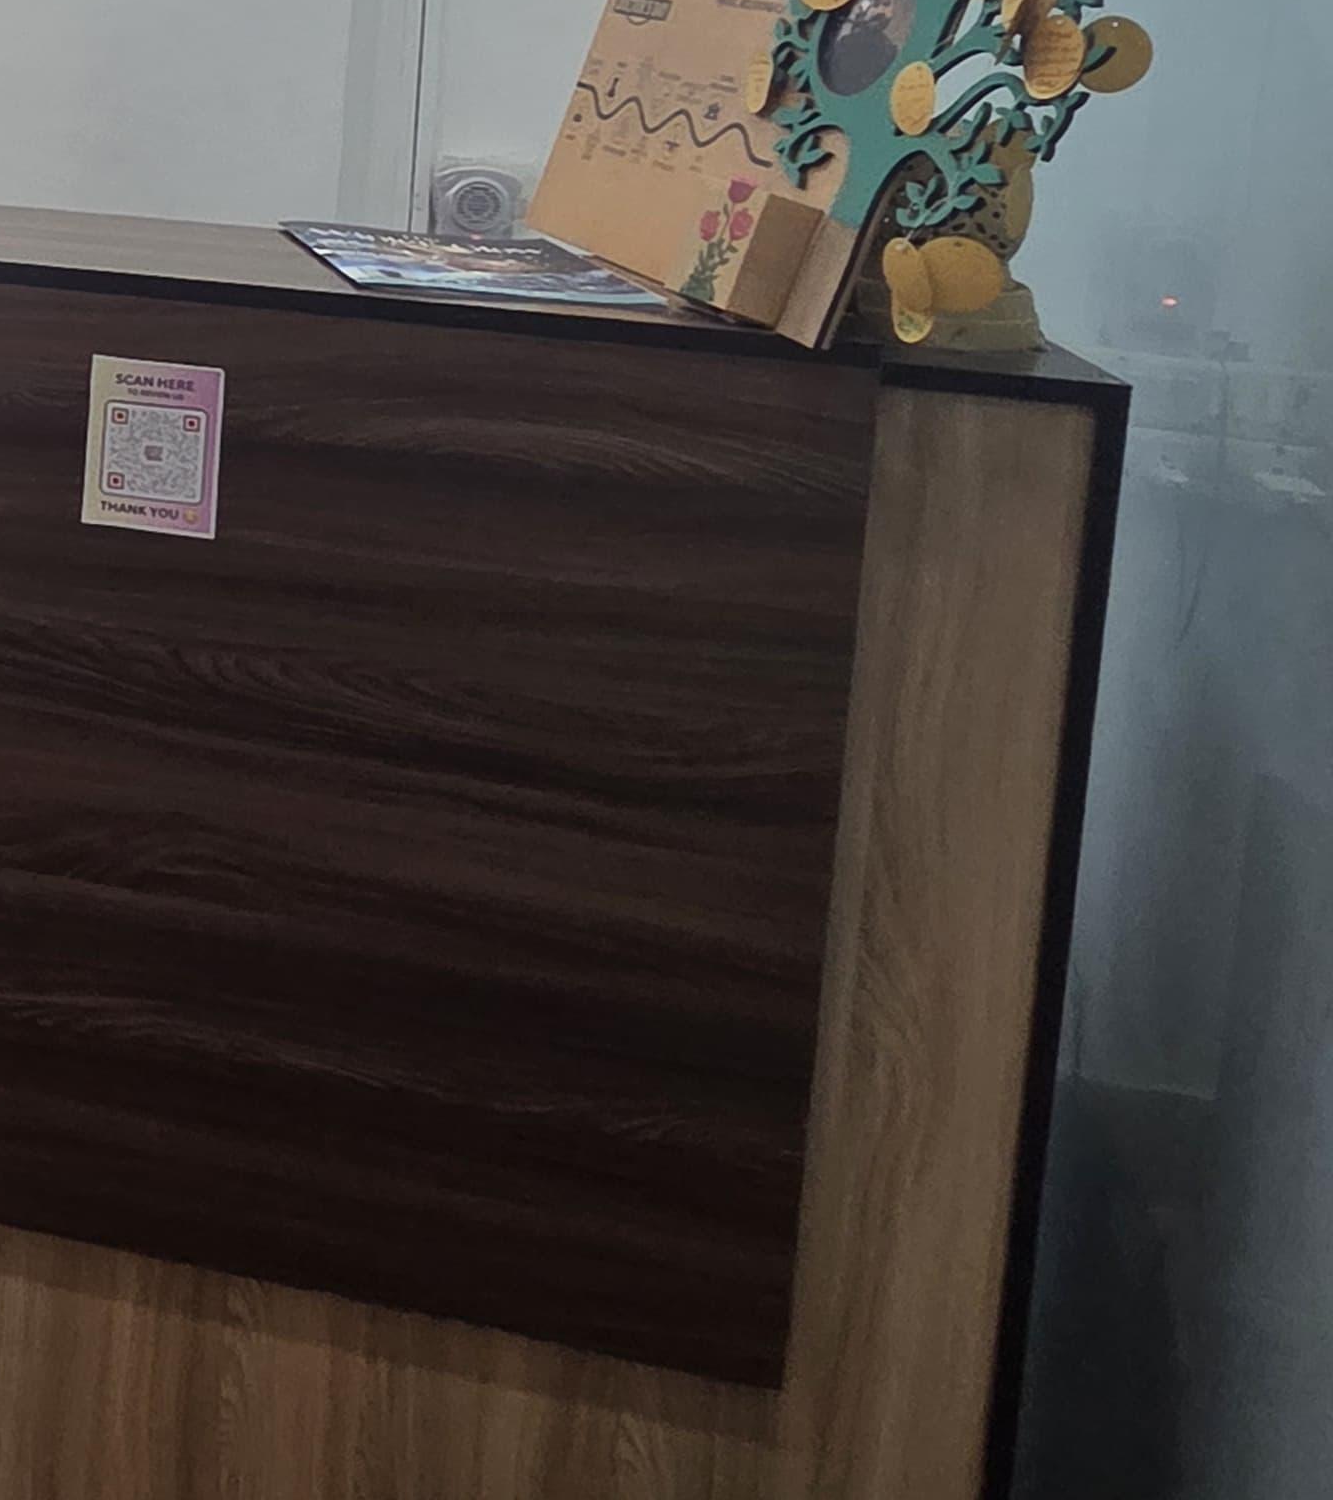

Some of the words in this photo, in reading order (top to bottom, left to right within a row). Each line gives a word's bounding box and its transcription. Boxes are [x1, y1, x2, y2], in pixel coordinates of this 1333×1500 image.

[115, 373, 154, 388] SCAN
[157, 377, 196, 392] HERE
[101, 500, 147, 516] THANK
[149, 506, 180, 521] YOU
